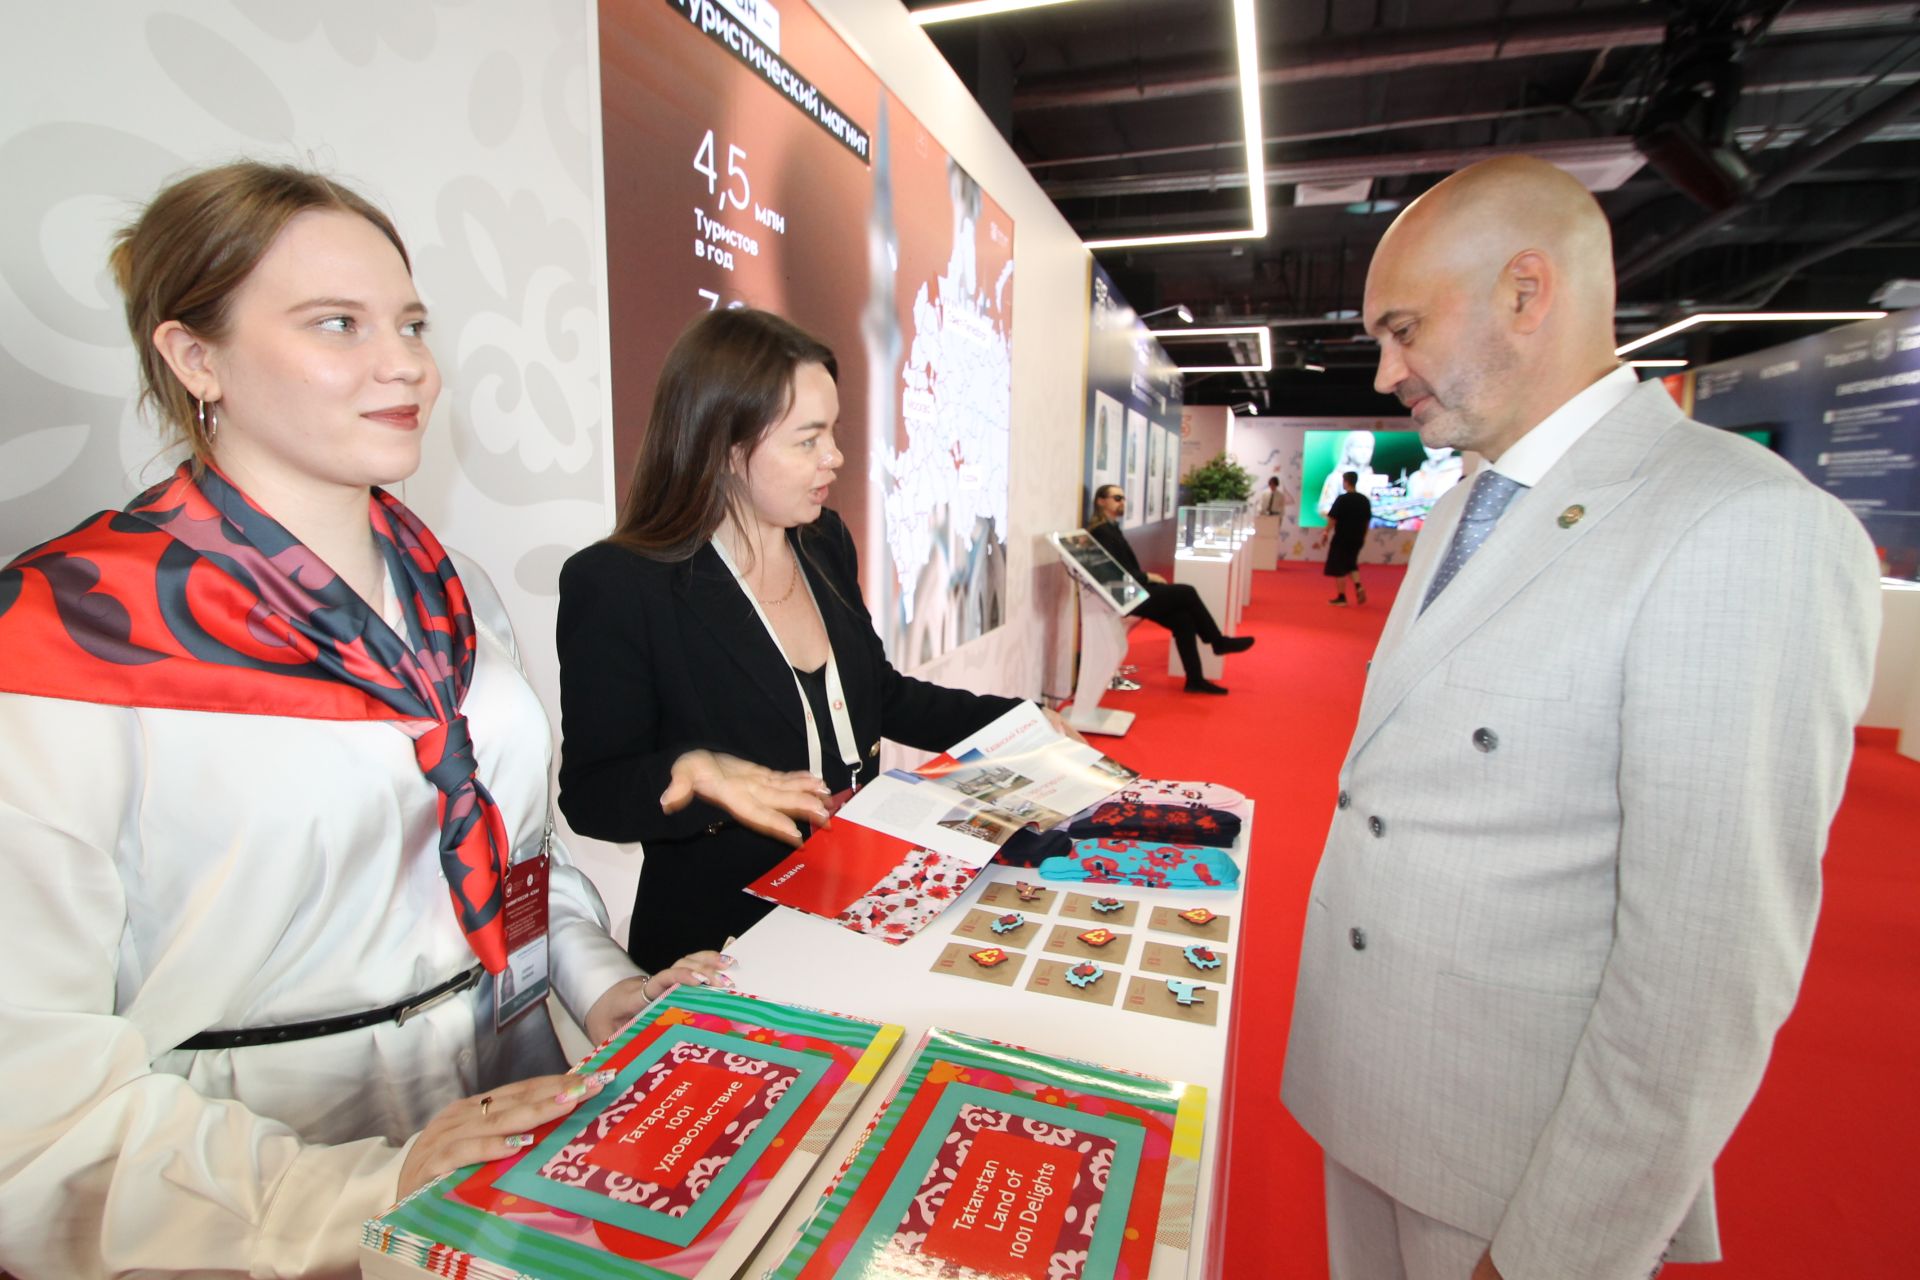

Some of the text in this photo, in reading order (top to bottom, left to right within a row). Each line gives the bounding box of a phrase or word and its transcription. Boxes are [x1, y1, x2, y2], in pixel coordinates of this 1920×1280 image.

[678, 0, 868, 156] уристический магнит
[693, 129, 785, 234] 4,5 млн
[694, 207, 759, 256] Туристов
[694, 239, 734, 271] в год
[770, 863, 806, 888] Казань
[618, 1081, 692, 1144] Татарстан
[653, 1081, 743, 1173] удовольствие
[665, 1105, 695, 1130] 1001
[952, 1159, 1000, 1230] Tatarstan
[984, 1168, 1024, 1232] Land of
[1009, 1162, 1056, 1259] 1001 Delights
